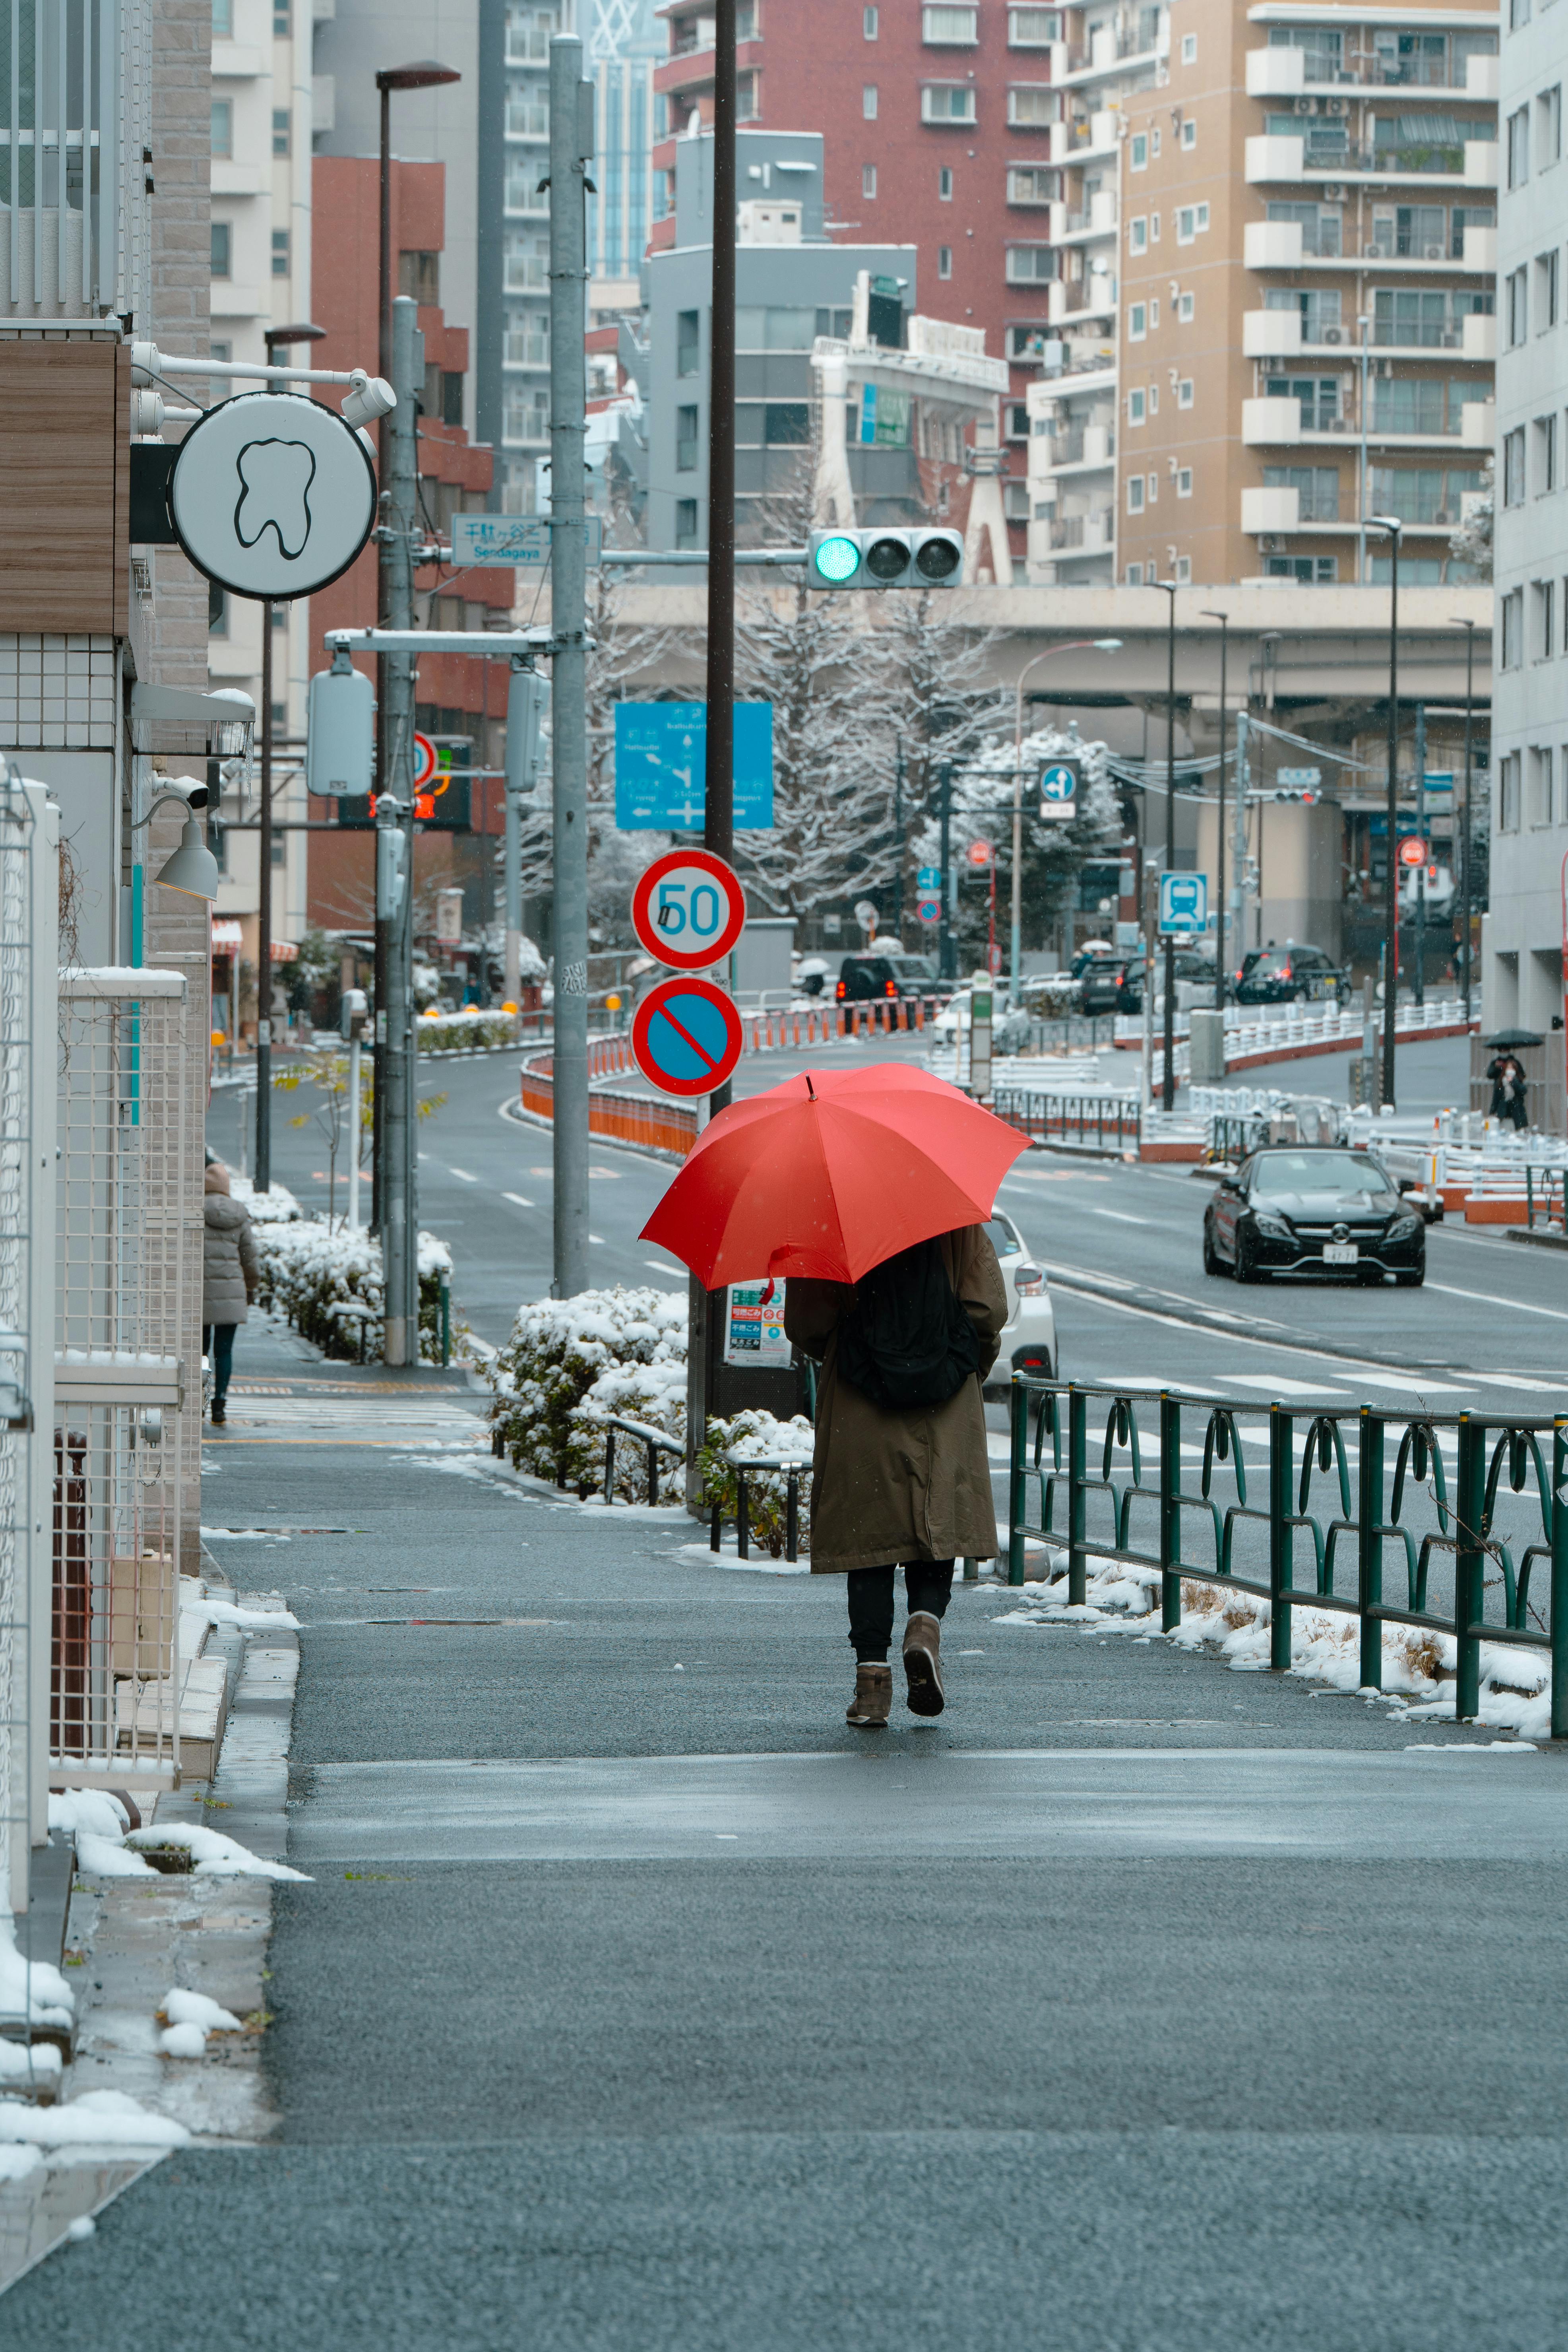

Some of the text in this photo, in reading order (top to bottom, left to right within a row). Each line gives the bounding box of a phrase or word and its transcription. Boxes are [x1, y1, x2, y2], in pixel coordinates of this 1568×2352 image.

[474, 547, 540, 560] Sendagaya
[659, 884, 719, 936] 50
[732, 1324, 760, 1332] 不燃ごみ
